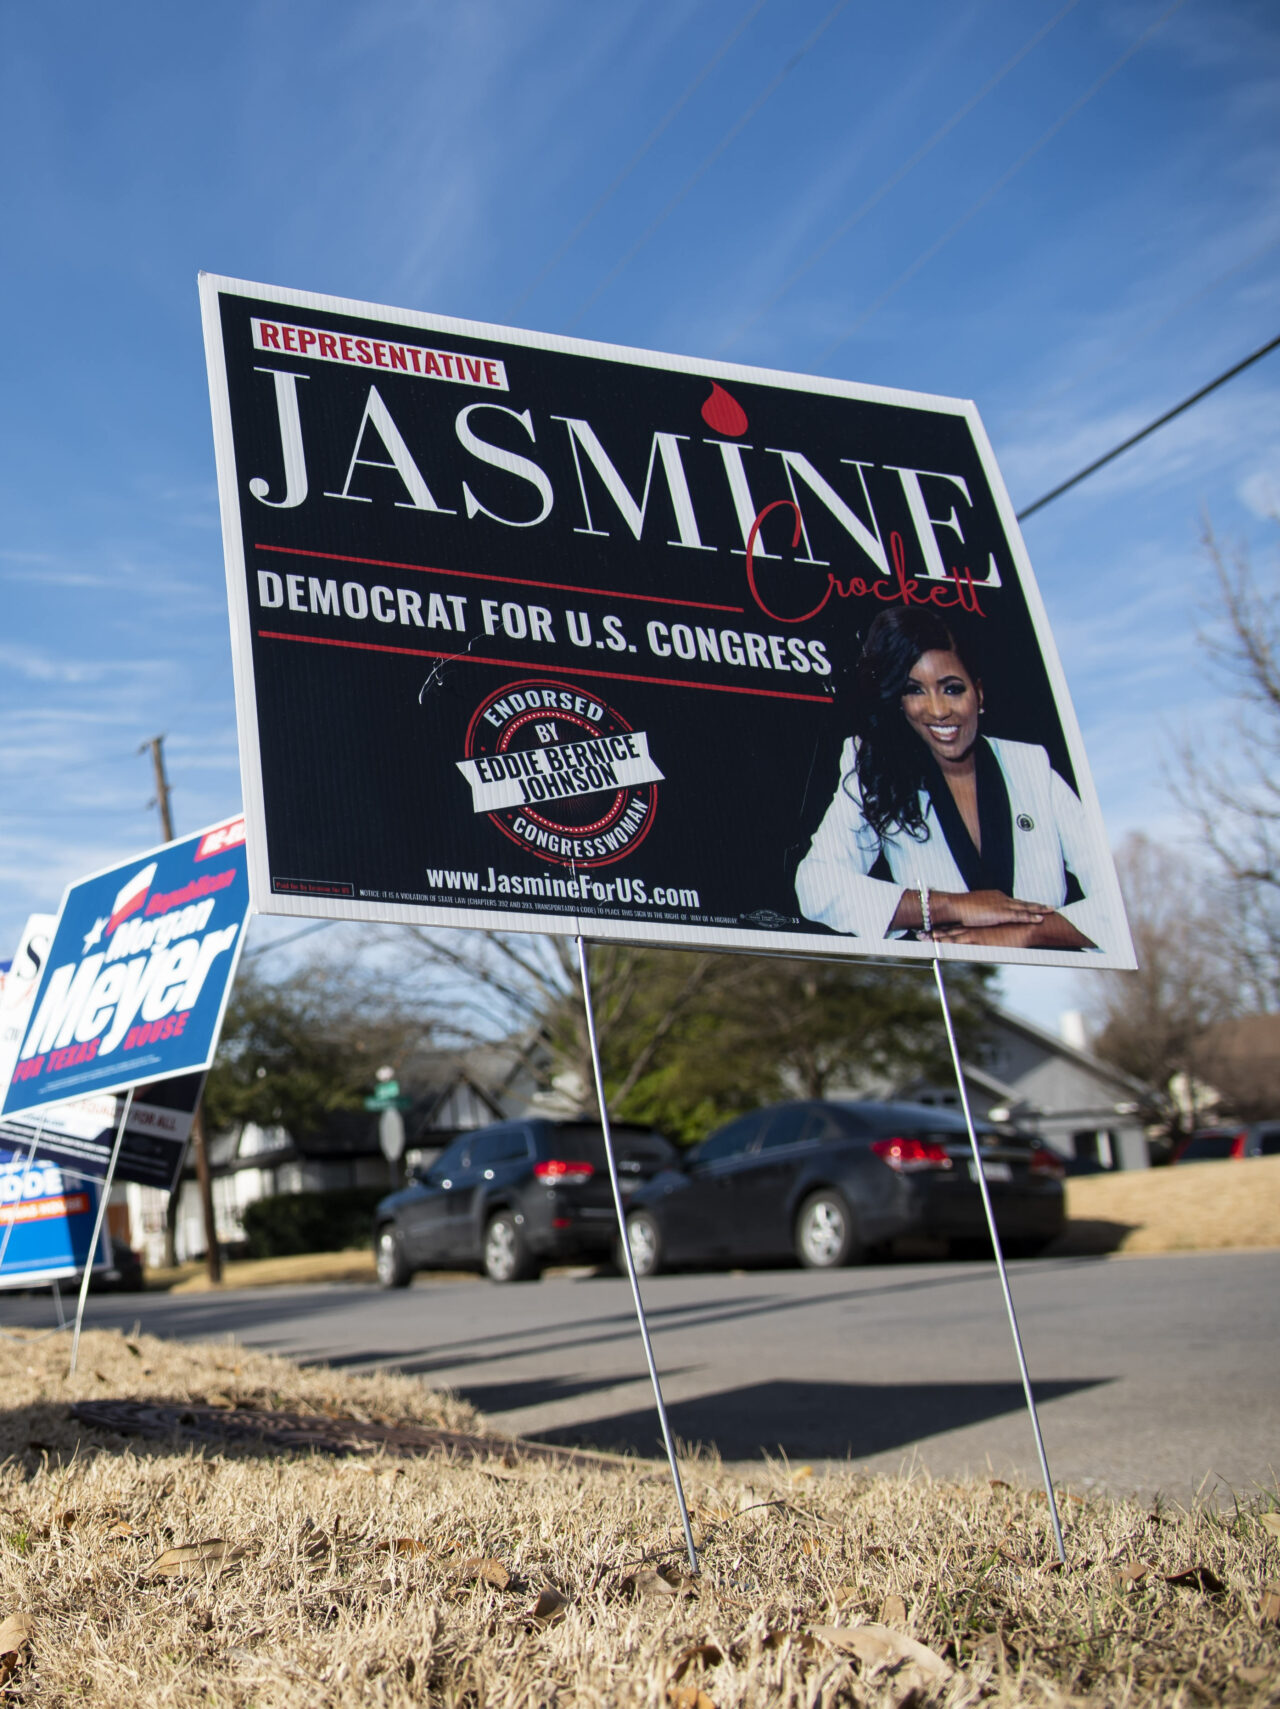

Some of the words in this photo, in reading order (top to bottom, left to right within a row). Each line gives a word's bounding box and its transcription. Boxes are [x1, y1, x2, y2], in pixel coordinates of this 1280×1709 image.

[260, 322, 501, 387] REPRESENTATIVE
[249, 366, 1002, 588] JASMINE
[746, 500, 988, 623] Crockett
[257, 570, 467, 632] DEMOCRAT
[480, 599, 557, 643] FOR
[565, 610, 637, 653] U.S.
[646, 620, 832, 676] CONGRESS
[483, 690, 604, 728] ENDORSED
[535, 722, 559, 743] BY
[474, 751, 544, 784] EDDIE
[543, 735, 640, 774] BERNICE
[518, 762, 619, 804] JOHNSON
[512, 798, 649, 858] CONGRESSWOMAN
[394, 891, 400, 899] A
[400, 891, 428, 901] VIOLATION
[429, 894, 436, 902] OF
[437, 894, 453, 903] STATE
[454, 896, 466, 904] LAW
[509, 900, 520, 908] AND
[426, 867, 700, 908] www.JasmineForUS.com
[104, 898, 216, 963] Morgan
[20, 923, 239, 1060] Meyer
[12, 1055, 45, 1083] FOR
[47, 1039, 101, 1073] TEXAS
[123, 1012, 190, 1050] HOUSE
